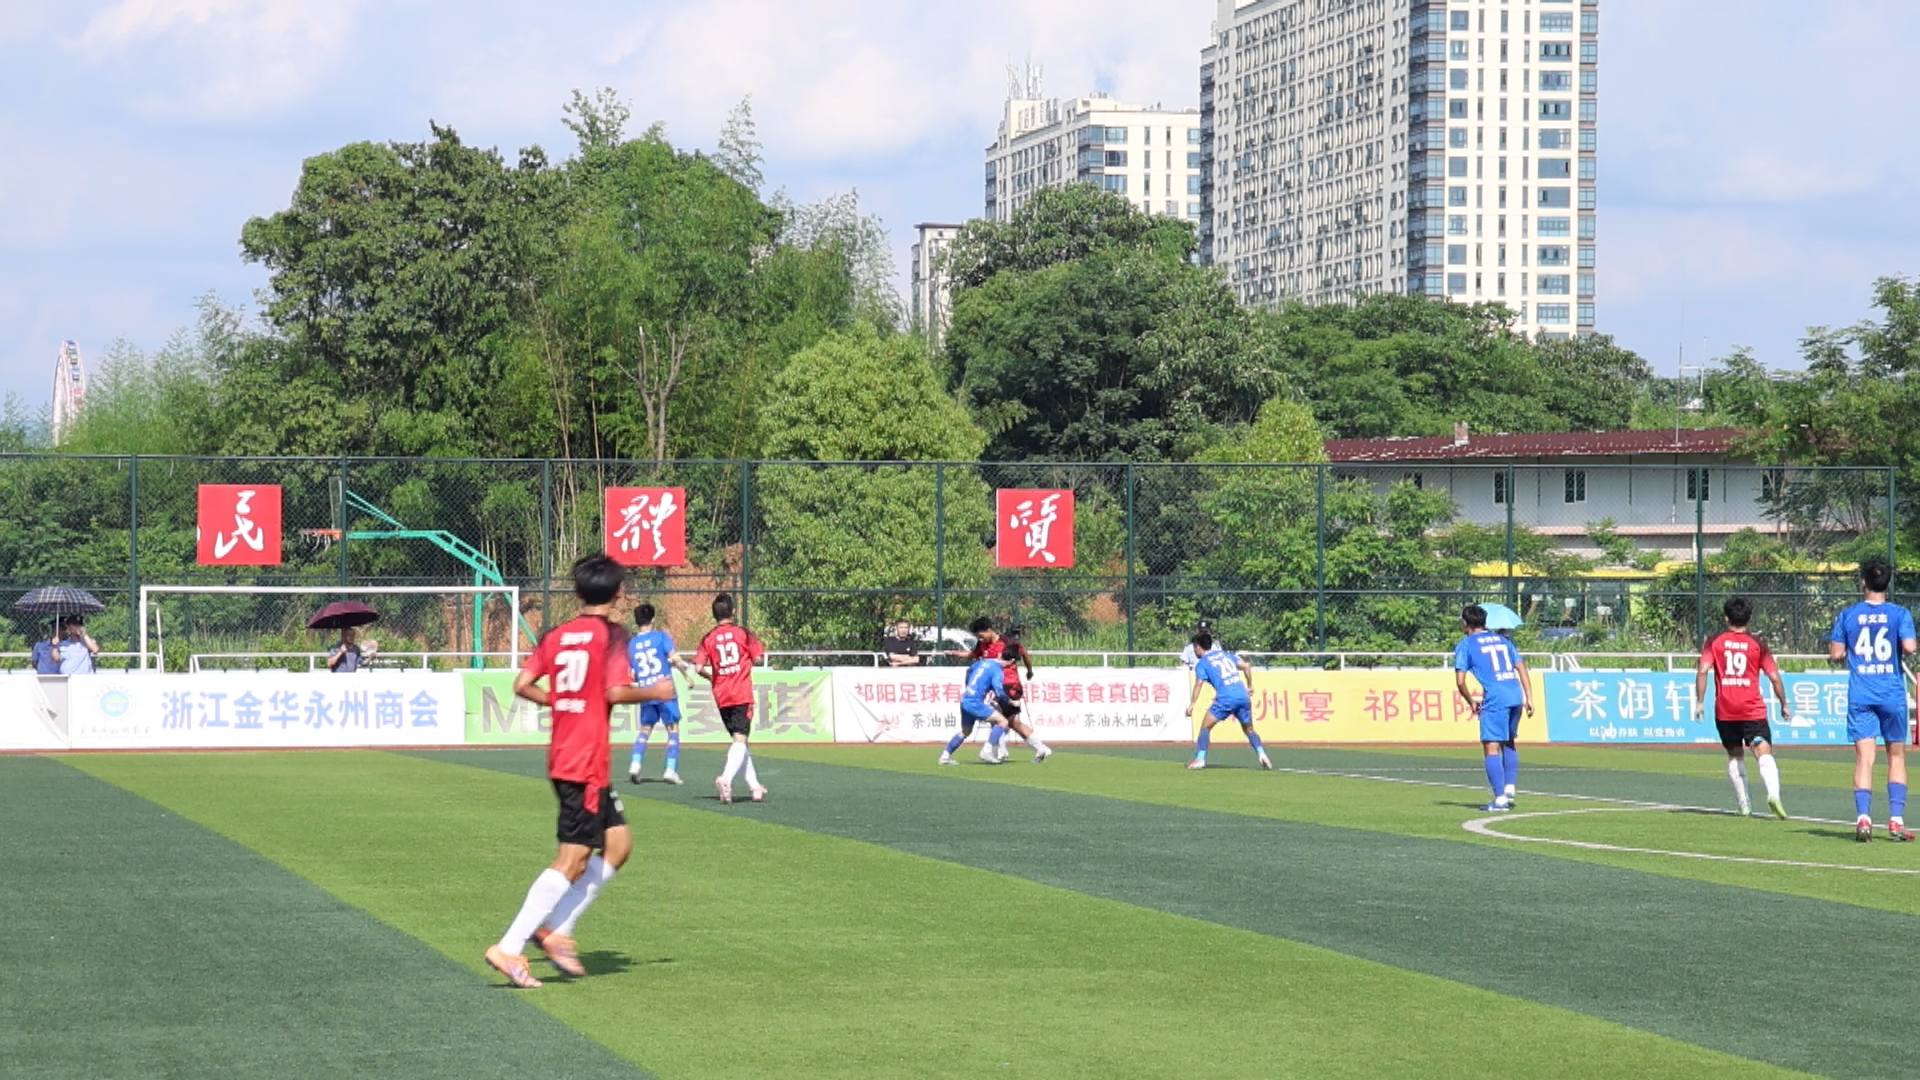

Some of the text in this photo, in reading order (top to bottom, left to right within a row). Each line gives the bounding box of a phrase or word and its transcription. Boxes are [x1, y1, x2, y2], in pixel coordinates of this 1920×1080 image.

[214, 490, 264, 559] 民
[715, 642, 740, 667] 13
[1480, 644, 1513, 672] 77
[1854, 626, 1892, 663] 46
[554, 650, 590, 694] 20
[634, 648, 662, 678] 35
[1211, 657, 1239, 680] 20
[1723, 650, 1748, 677] 19
[1023, 682, 1171, 703] 非遗美食真的香
[1567, 678, 1697, 721] 茶润轩
[161, 689, 439, 729] 浙江金华永州商会
